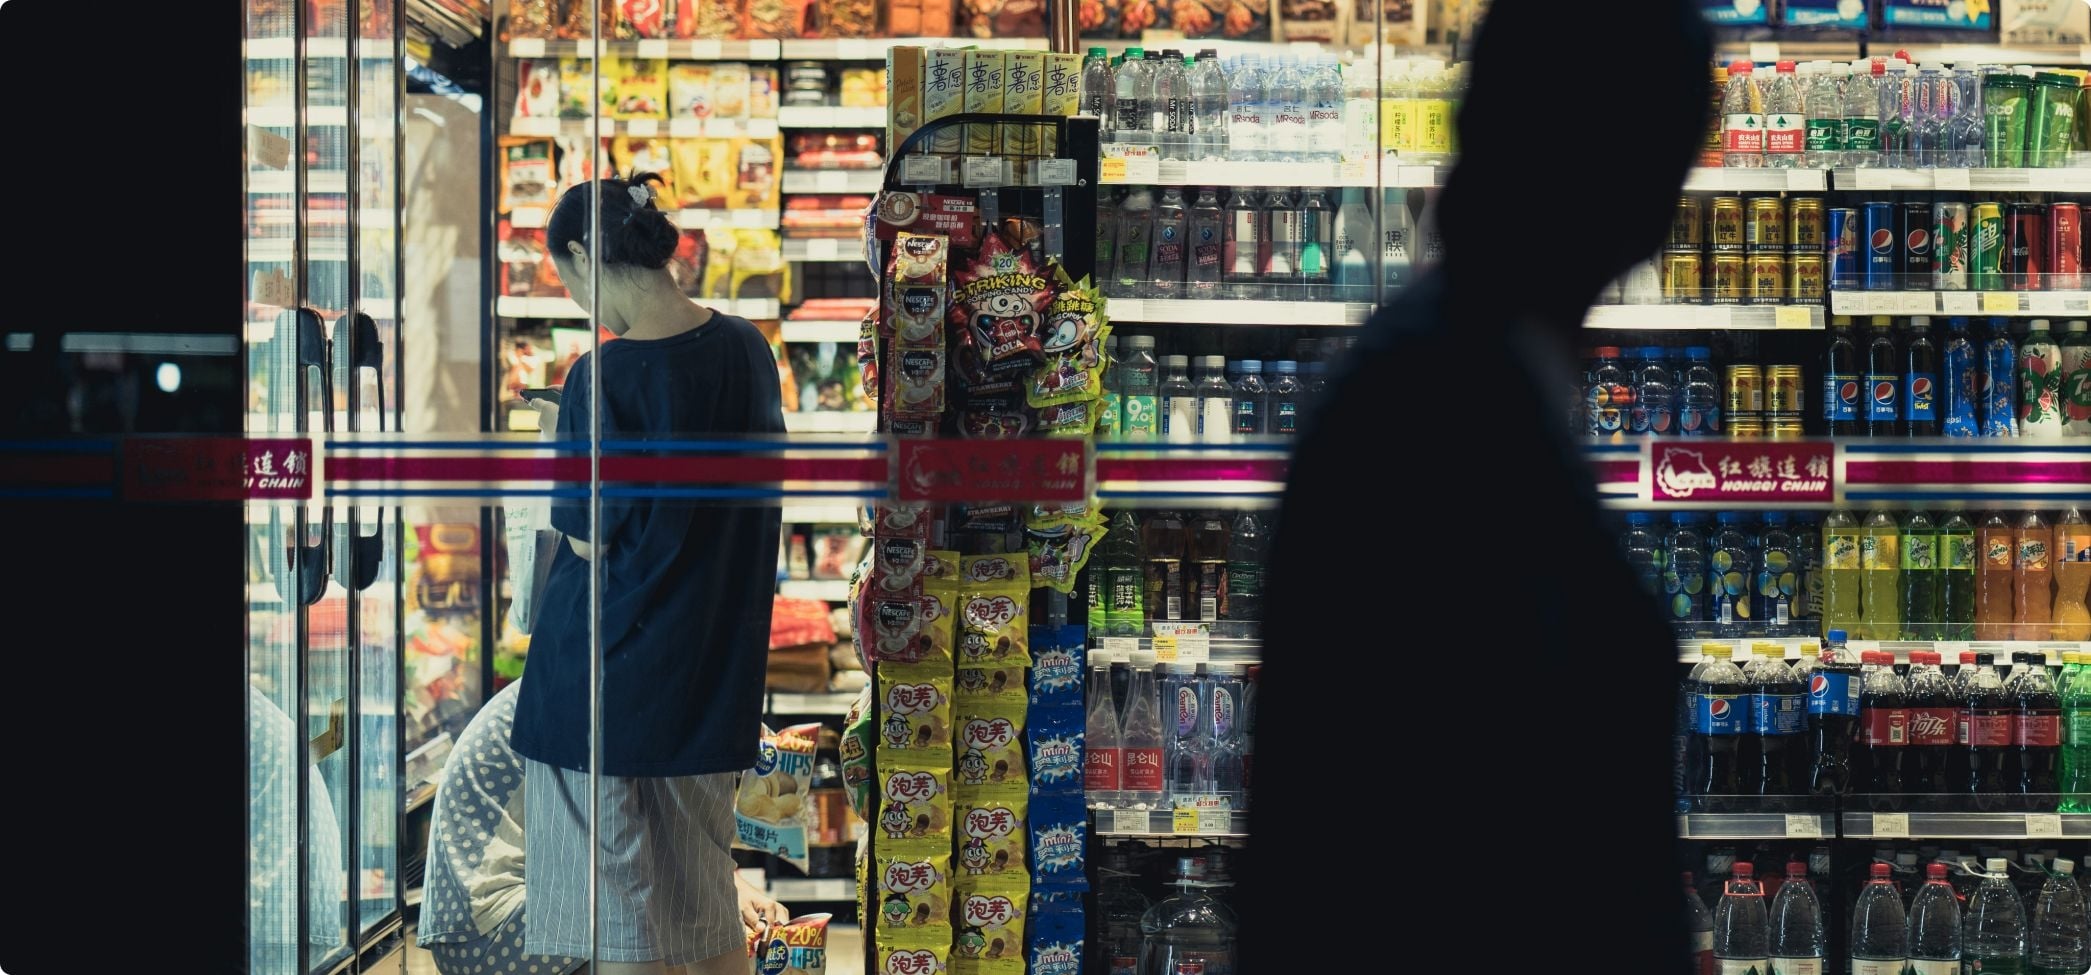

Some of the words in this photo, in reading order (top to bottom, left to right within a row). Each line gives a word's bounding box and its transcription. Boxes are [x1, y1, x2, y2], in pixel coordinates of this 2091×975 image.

[928, 60, 964, 92] 薯愿
[966, 61, 1003, 93] 薯愿
[1006, 62, 1041, 95] 薯愿
[1046, 64, 1080, 96] 薯愿
[1169, 100, 1177, 109] Mr
[1169, 110, 1177, 131] SODA
[1275, 114, 1305, 124] MRsoda
[999, 258, 1012, 268] 20
[951, 273, 1047, 304] STRIKING
[968, 290, 1003, 304] POPPING
[1003, 287, 1035, 298] CANDY
[993, 339, 1025, 356] COLA
[1127, 399, 1150, 422] 9.0
[1718, 455, 1830, 479] 红旗连锁
[258, 477, 305, 489] CHAIN
[1033, 480, 1077, 491] HAIN
[1720, 479, 1778, 492] HONGQI
[1780, 479, 1828, 492] CHAIN
[966, 506, 1012, 518] STRAWBERRY
[973, 560, 1008, 580] 泡芙
[970, 602, 1013, 622] 泡芙
[1043, 657, 1070, 668] mini
[893, 688, 932, 708] 泡芙
[967, 722, 1008, 744] 泡芙
[1041, 745, 1070, 757] mini
[1127, 752, 1160, 768] 昆仑山
[891, 776, 931, 797] 泡芙
[969, 812, 1010, 833] 泡芙
[1044, 834, 1073, 846] mini
[889, 865, 929, 886] 泡芙
[967, 900, 1008, 921] 泡芙
[789, 926, 823, 946] 20%
[891, 953, 931, 972] 泡芙
[1042, 952, 1071, 964] mini
